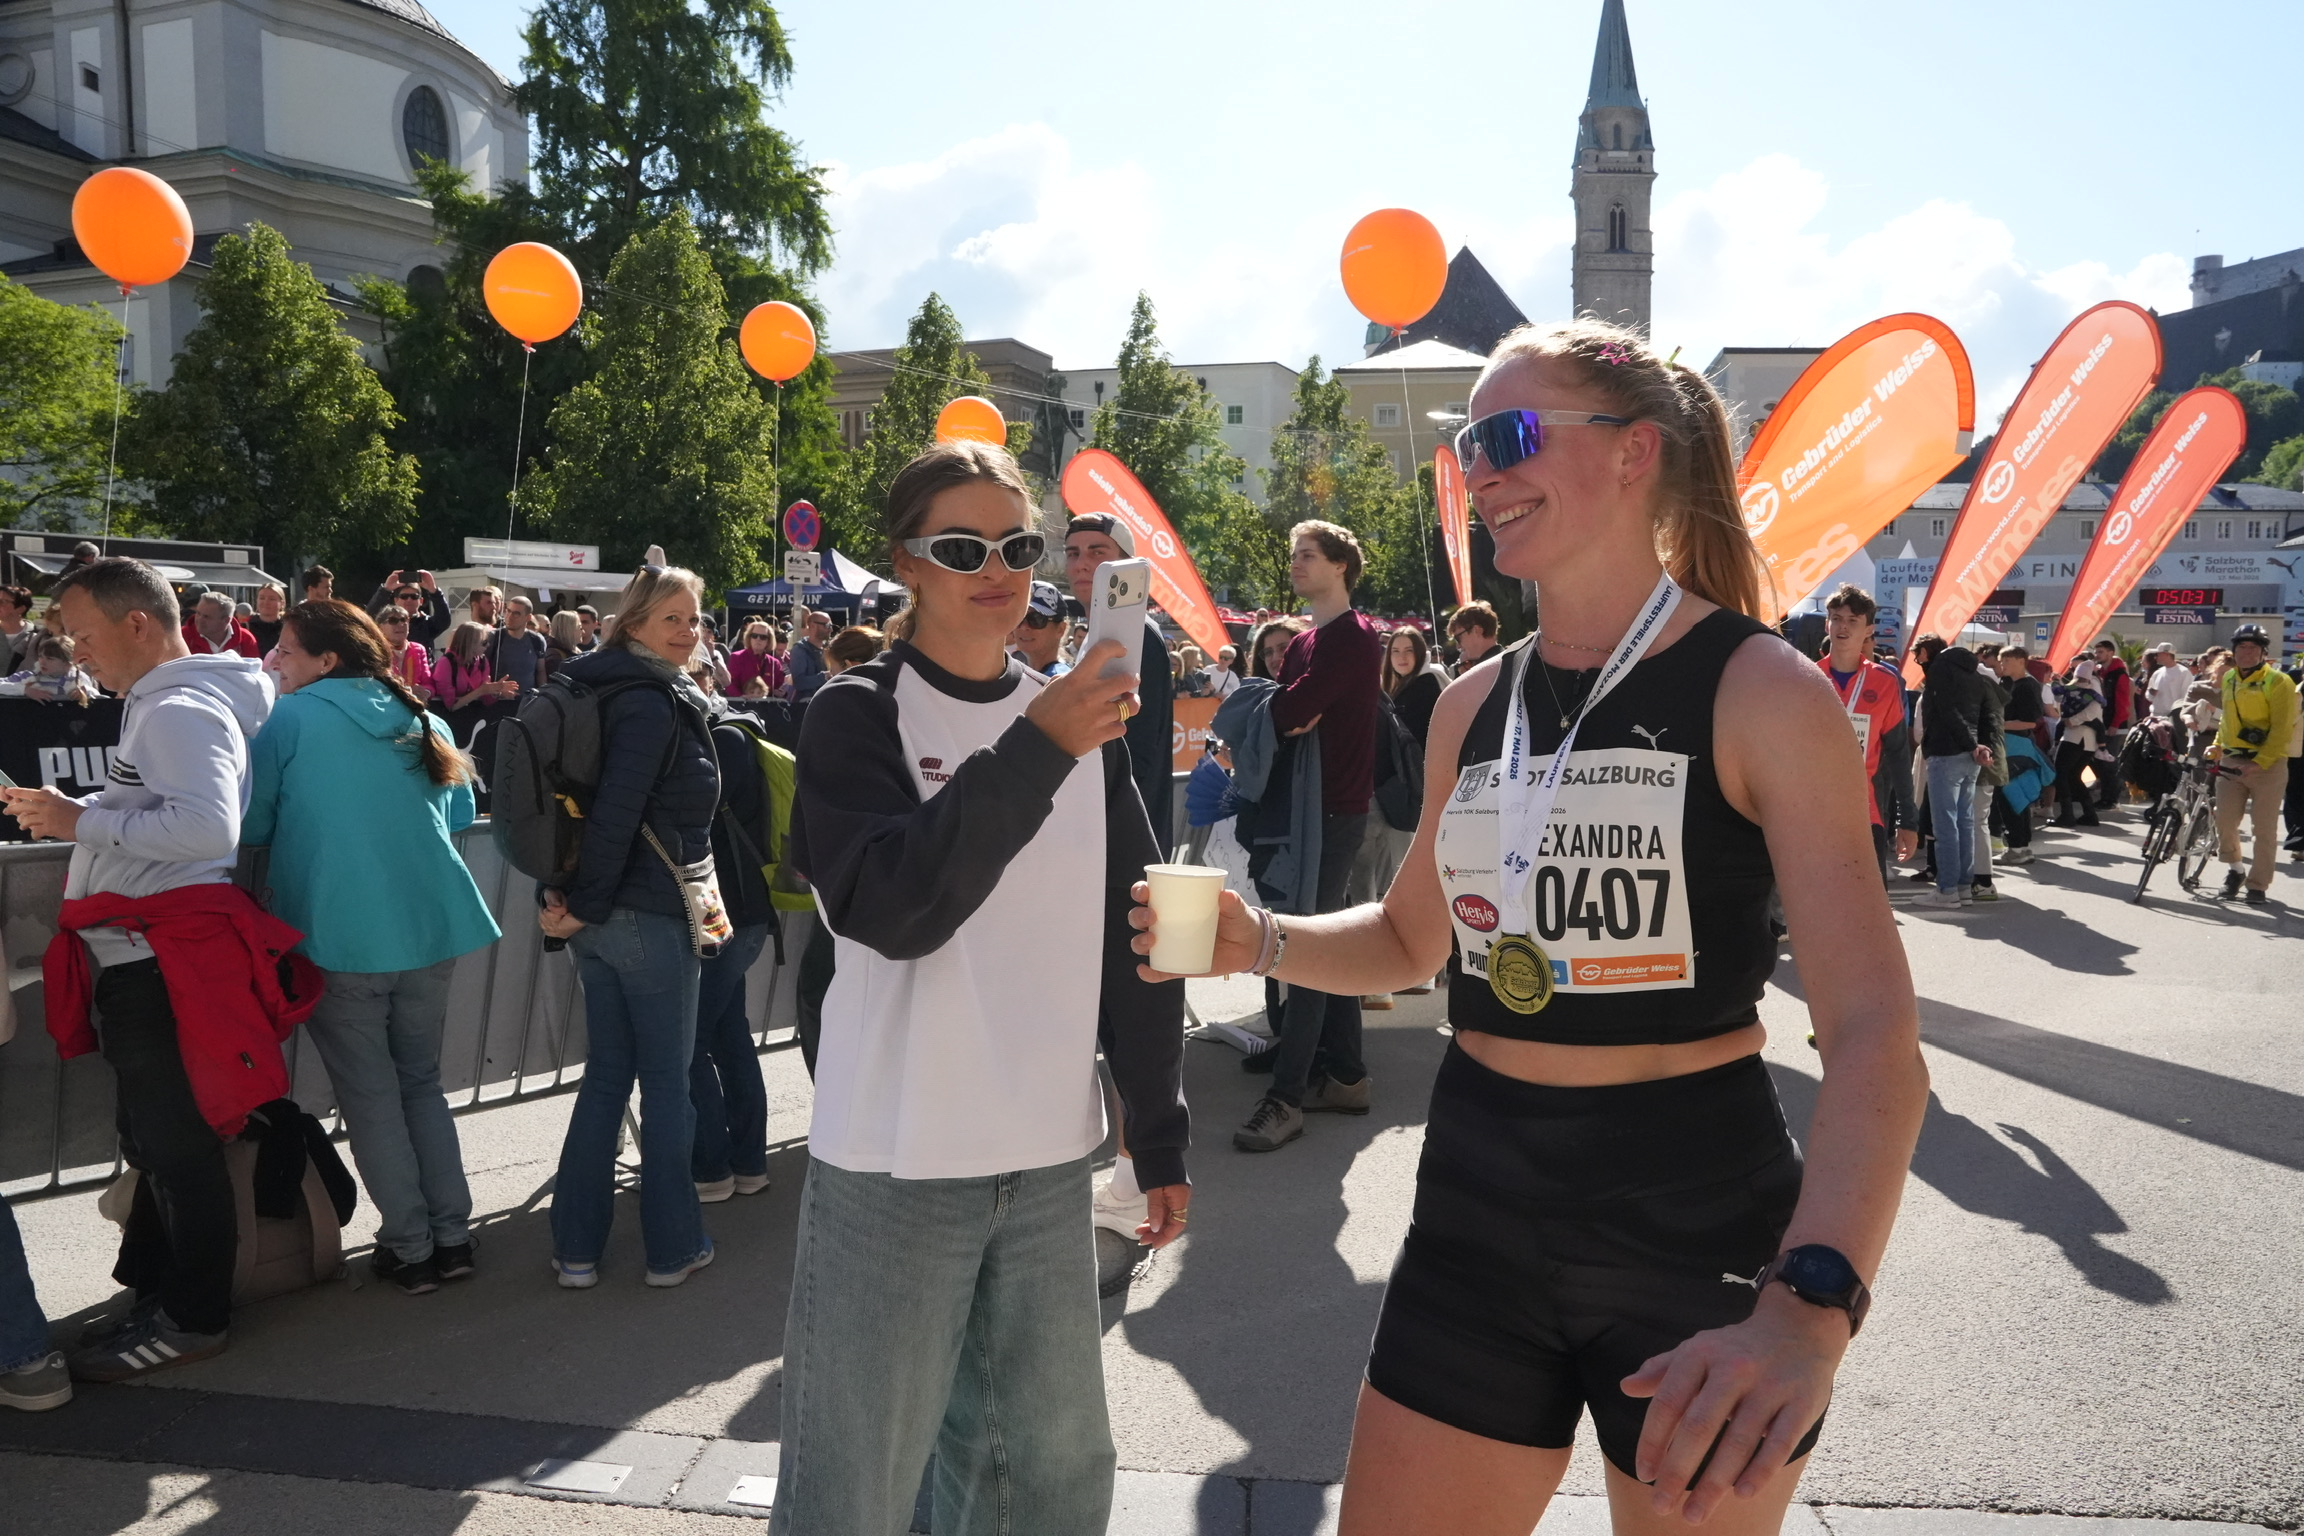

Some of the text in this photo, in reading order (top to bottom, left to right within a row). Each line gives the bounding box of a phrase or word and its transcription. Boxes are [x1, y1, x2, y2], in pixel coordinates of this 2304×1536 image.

[2012, 333, 2114, 464] Gebrüder Weiss
[1780, 338, 1937, 491] Gebrüder Weiss
[2020, 395, 2081, 471] Transport and Logistics
[1788, 415, 1883, 504] Transport and Logistics
[2129, 411, 2208, 513] Gebrüder Weiss
[1955, 495, 2027, 584] www.gw-world.com
[1881, 563, 1934, 573] Lauffes
[2032, 562, 2077, 578] FIN
[2205, 556, 2255, 566] Salzburg
[2205, 565, 2260, 574] Marathon
[1881, 573, 1903, 583] der
[2085, 538, 2141, 608] www.gw-world.com
[747, 594, 822, 605] GET MOIN'
[2156, 590, 2217, 605] 0:50:31
[1973, 614, 2009, 623] ESTINA
[2155, 614, 2203, 624] FESTINA
[1585, 585, 1674, 708] LAUFFESTSPIELE DER MOZART
[1188, 727, 1217, 742] Geb
[1511, 738, 1521, 757] MAI
[922, 770, 954, 783] TUDIO
[1509, 757, 1520, 780] 2026
[1560, 765, 1676, 788] SALZBURG
[1446, 808, 1463, 816] Hervis
[1475, 808, 1499, 816] Salzburg
[1550, 807, 1567, 815] 2026
[1538, 824, 1666, 860] EXANDRA
[1535, 865, 1671, 941] 0407
[1455, 901, 1495, 925] Hervis
[1466, 918, 1481, 926] SPORTS
[1467, 950, 1488, 973] PUM
[1603, 964, 1680, 976] Gebrüder Weiss
